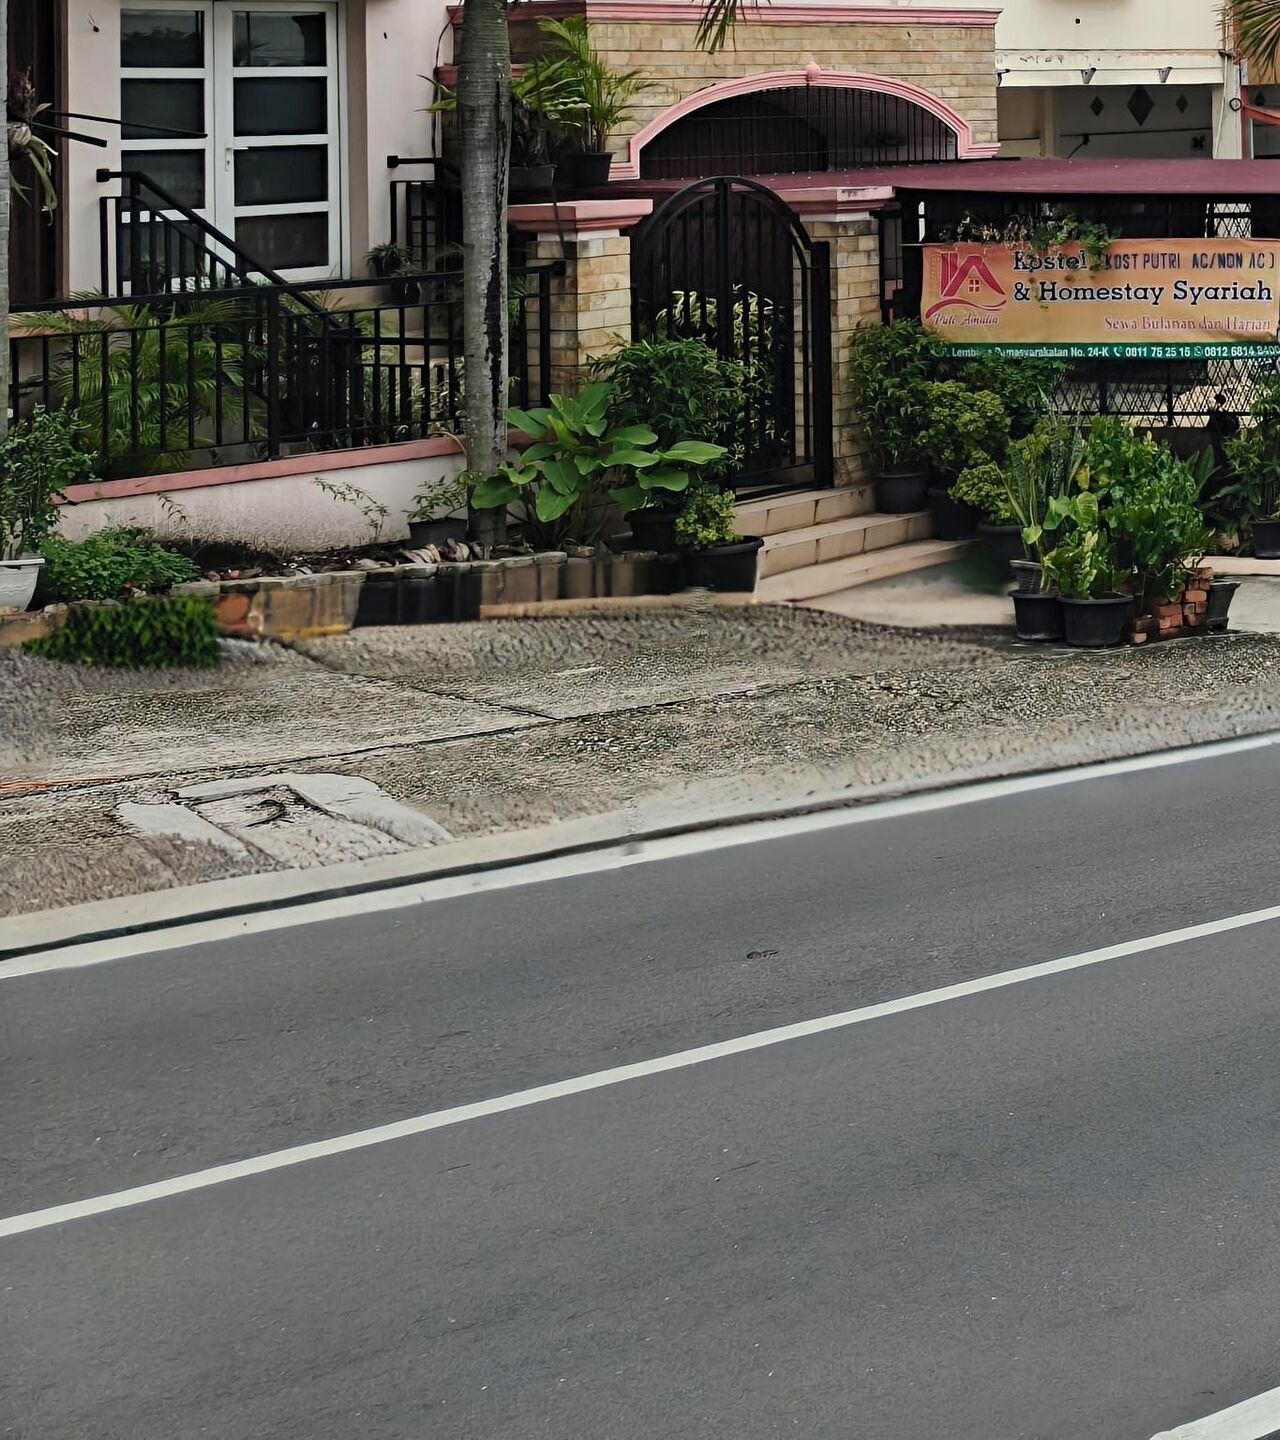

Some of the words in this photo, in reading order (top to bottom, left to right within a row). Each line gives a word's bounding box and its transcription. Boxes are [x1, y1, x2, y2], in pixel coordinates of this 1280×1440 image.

[1012, 249, 1087, 272] Kostel
[1143, 252, 1181, 270] PUTRI
[1013, 281, 1031, 302] &
[1038, 280, 1164, 306] Homestay
[1172, 279, 1273, 306] Syariah
[1104, 317, 1138, 330] Sewa
[1141, 316, 1196, 330] Bulanan
[1198, 316, 1222, 330] dan
[1226, 317, 1271, 331] Harian
[1071, 346, 1086, 358] No.
[1087, 346, 1110, 358] 24-K
[1125, 346, 1148, 358] 0811
[1204, 346, 1229, 358] 0812
